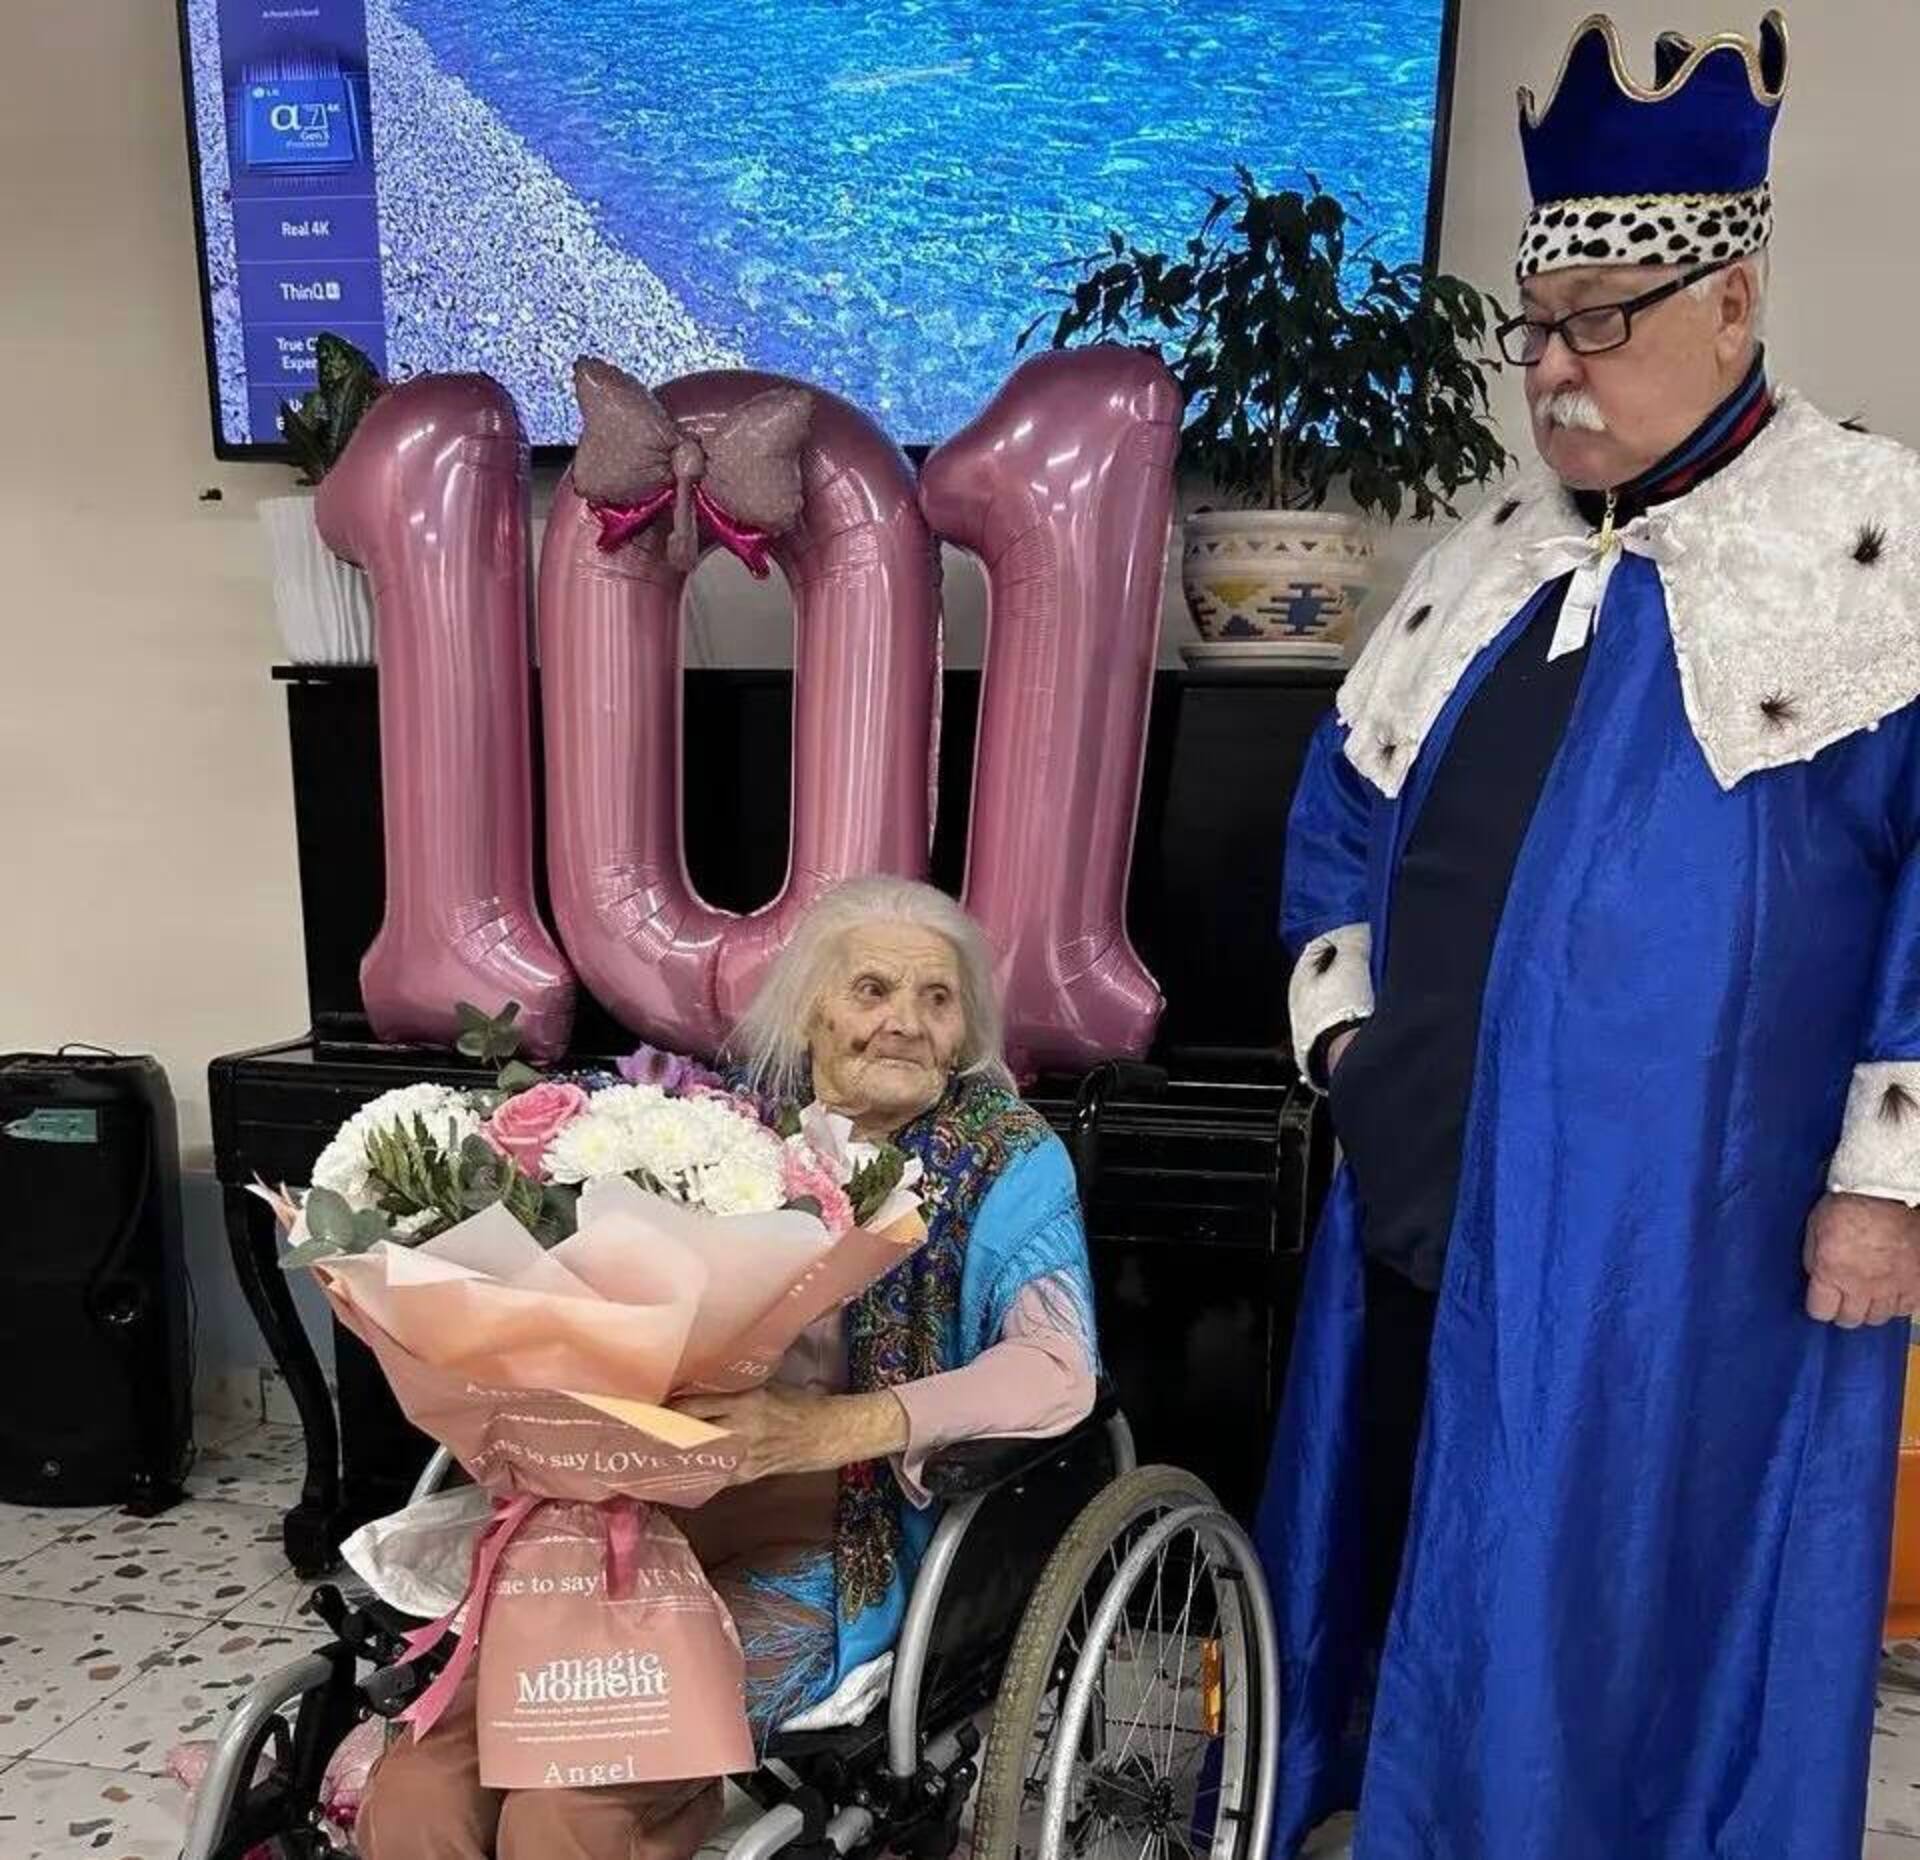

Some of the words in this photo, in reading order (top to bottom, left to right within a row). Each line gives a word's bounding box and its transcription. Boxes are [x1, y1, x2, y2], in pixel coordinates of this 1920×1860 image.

[281, 222, 310, 236] Real
[311, 221, 330, 236] 4K
[279, 282, 326, 301] ThinQ
[275, 336, 304, 352] True
[282, 355, 318, 374] Exper
[549, 1452, 589, 1471] say
[530, 1576, 555, 1593] to
[560, 1574, 599, 1597] say
[547, 1648, 659, 1684] magic
[515, 1665, 673, 1702] Moment
[543, 1754, 635, 1786] Angel
